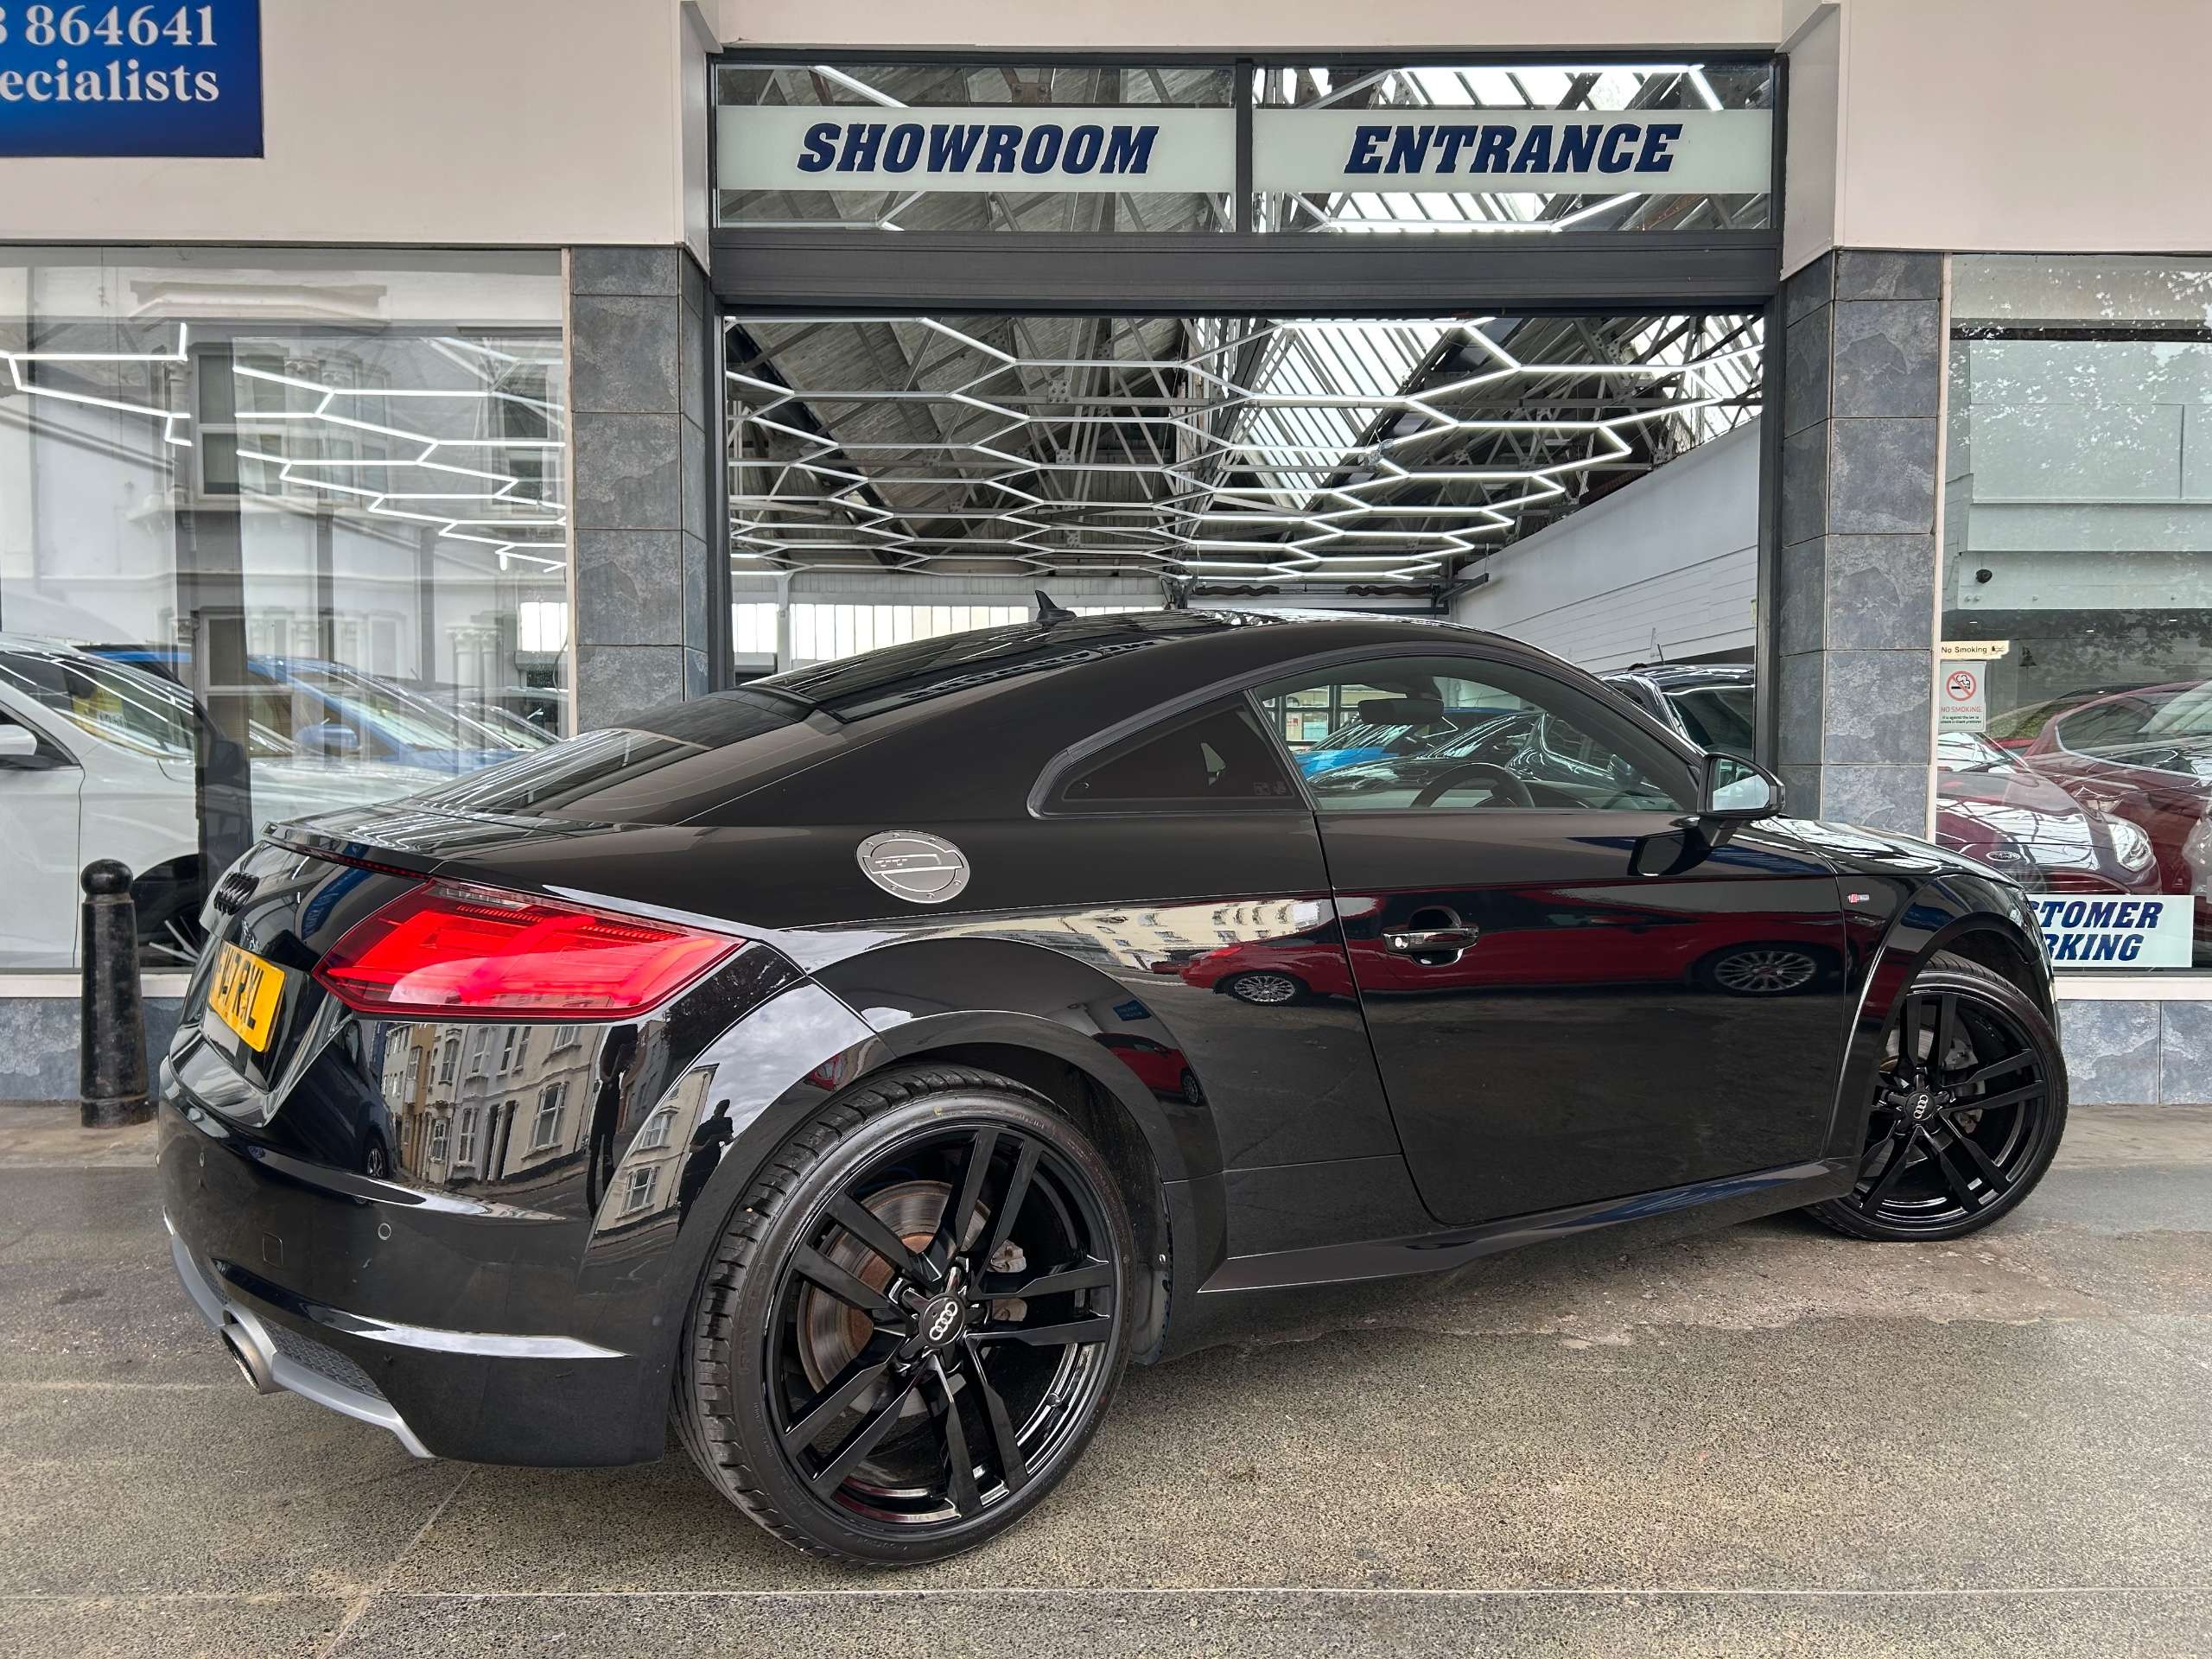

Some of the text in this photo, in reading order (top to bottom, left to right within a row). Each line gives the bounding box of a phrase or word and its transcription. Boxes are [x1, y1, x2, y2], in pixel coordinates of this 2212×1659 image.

[25, 4, 218, 46] 864641
[797, 123, 1683, 174] SHOWROOM ENTRANCE
[1955, 645, 1987, 654] Smoking
